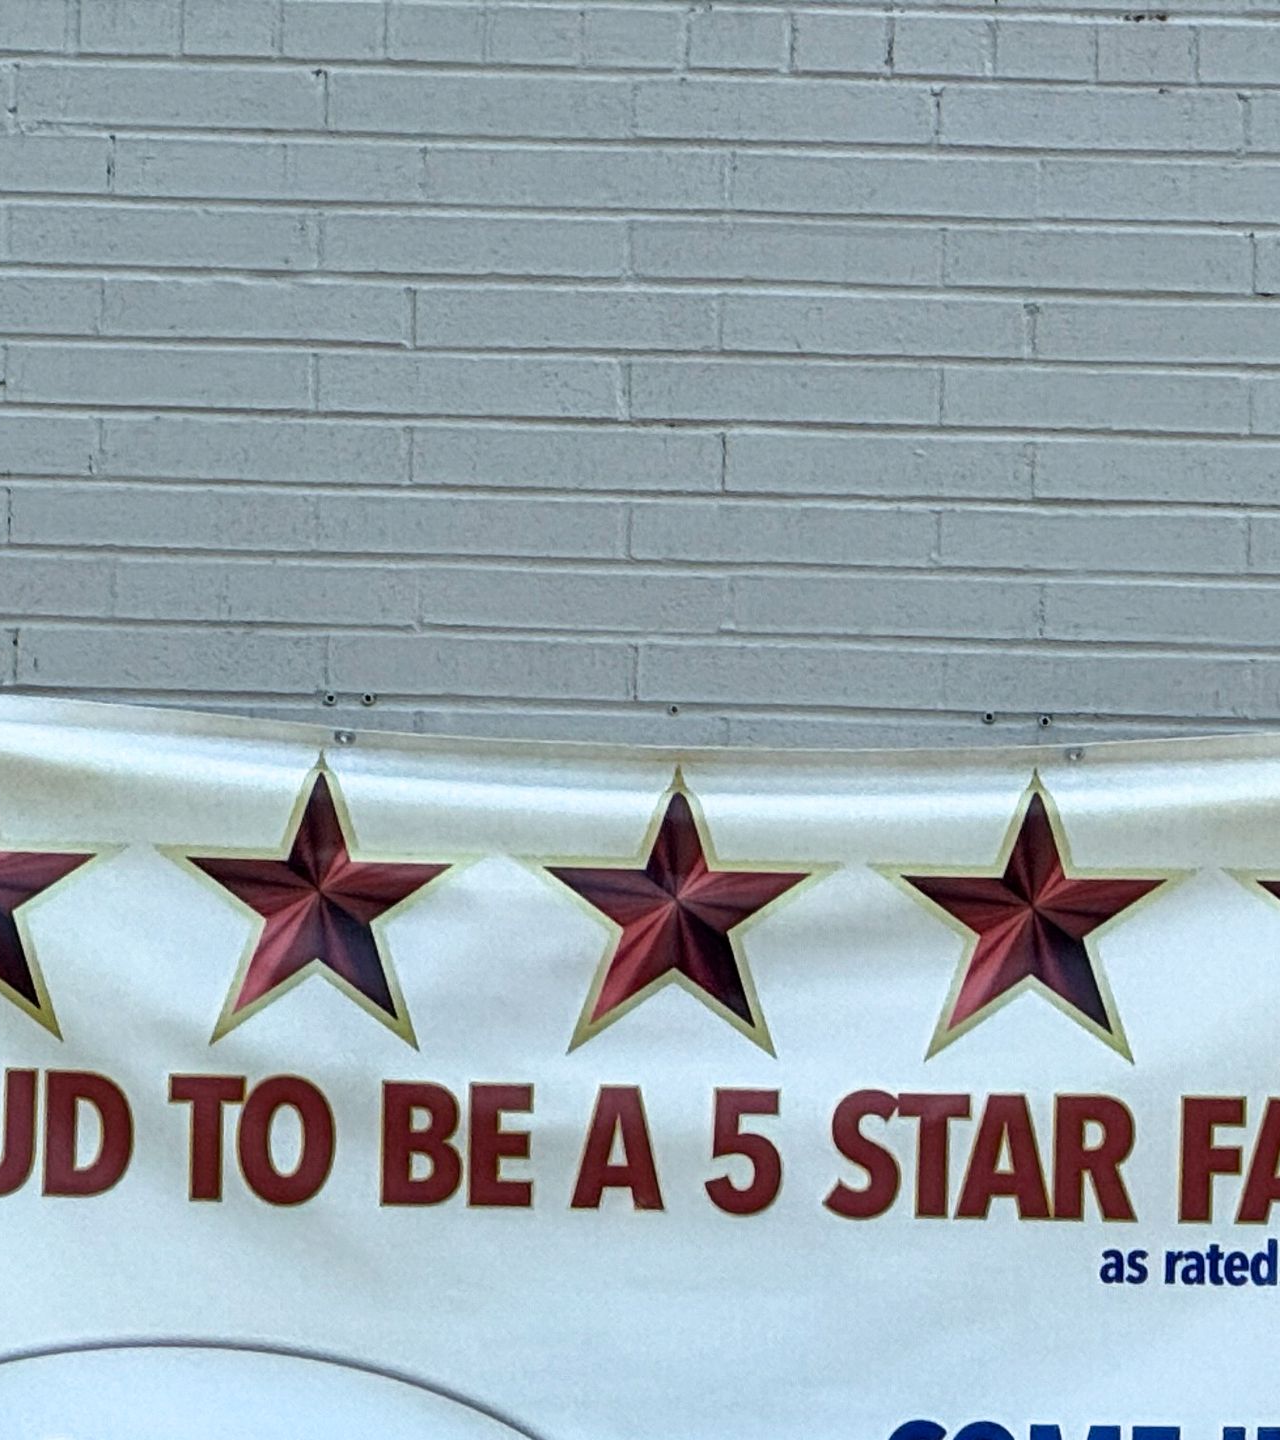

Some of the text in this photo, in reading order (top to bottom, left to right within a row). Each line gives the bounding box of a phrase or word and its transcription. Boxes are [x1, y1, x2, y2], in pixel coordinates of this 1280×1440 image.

[169, 1075, 336, 1207] TO
[380, 1081, 533, 1208] BE
[571, 1087, 664, 1210] A
[705, 1090, 782, 1216] 5
[823, 1090, 1137, 1222] STAR
[1100, 1250, 1148, 1284] as
[1165, 1239, 1277, 1286] rated
